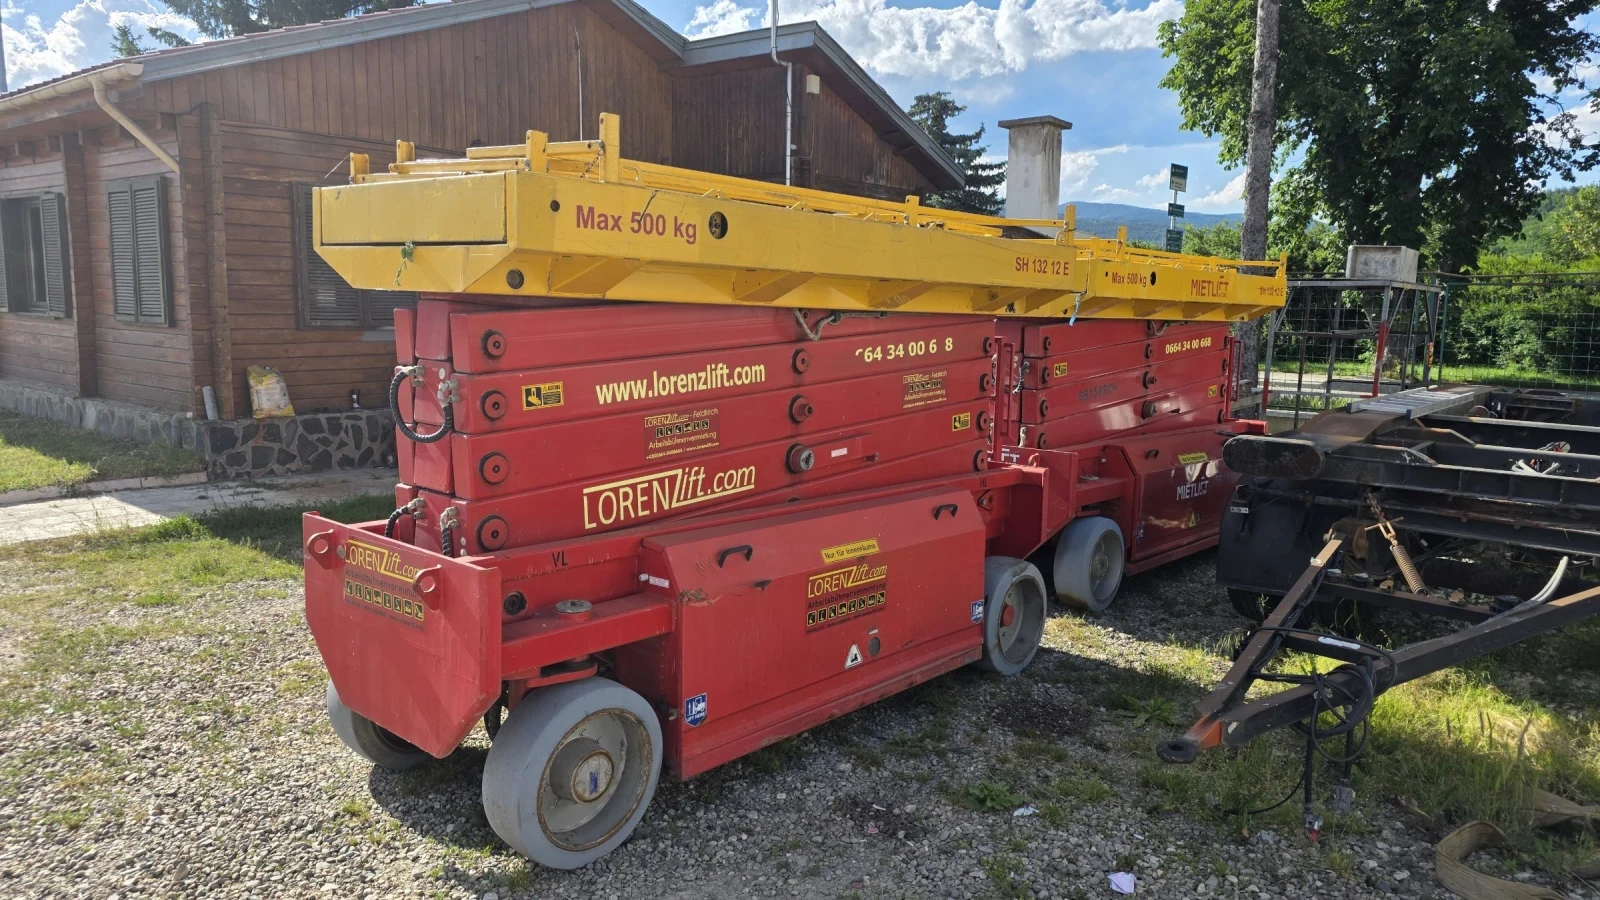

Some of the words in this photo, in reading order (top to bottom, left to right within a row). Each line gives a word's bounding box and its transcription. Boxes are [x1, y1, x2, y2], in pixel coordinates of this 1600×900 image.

[575, 204, 622, 232] Max
[630, 211, 667, 237] 500
[673, 215, 697, 245] kg
[1015, 256, 1030, 272] SH
[1032, 258, 1048, 274] 132
[1051, 260, 1061, 275] 12
[1063, 261, 1070, 276] E
[1111, 271, 1125, 284] Max
[1126, 272, 1138, 285] 500
[1139, 273, 1148, 288] kg
[887, 343, 905, 360] 34
[908, 340, 925, 357] 00
[1165, 343, 1182, 355] 0664
[1182, 340, 1191, 351] 34
[1191, 338, 1200, 350] 00
[1200, 336, 1212, 348] 668
[595, 362, 766, 405] www.lorenzlift.com
[693, 407, 718, 419] Feldkirch
[551, 550, 568, 568] VL
[824, 551, 836, 560] Nur
[836, 548, 845, 557] für
